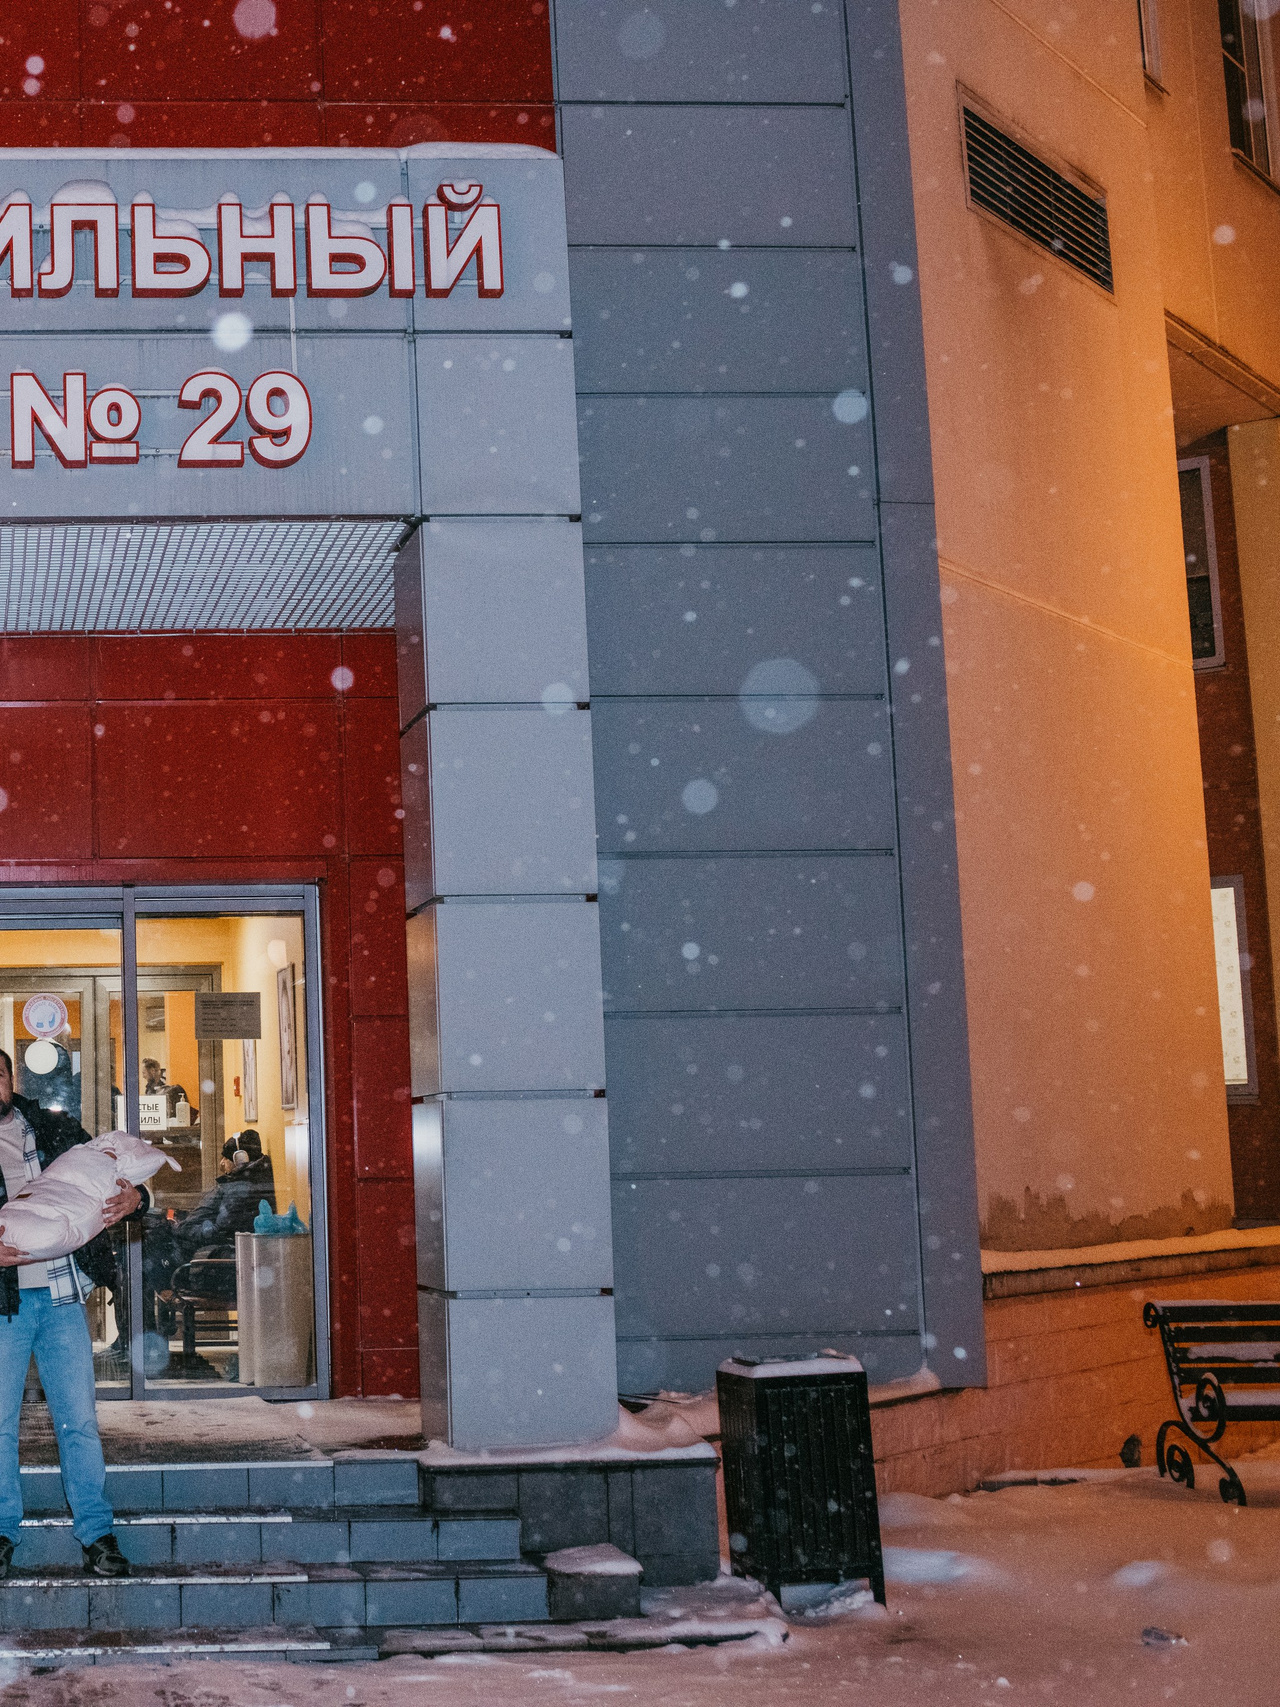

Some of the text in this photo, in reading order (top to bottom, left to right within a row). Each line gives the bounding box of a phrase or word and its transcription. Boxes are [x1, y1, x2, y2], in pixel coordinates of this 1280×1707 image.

[9, 372, 141, 469] №
[177, 370, 313, 469] 29
[138, 1103, 159, 1111] СТЫЕ
[140, 1116, 161, 1124] ИЛЫ
